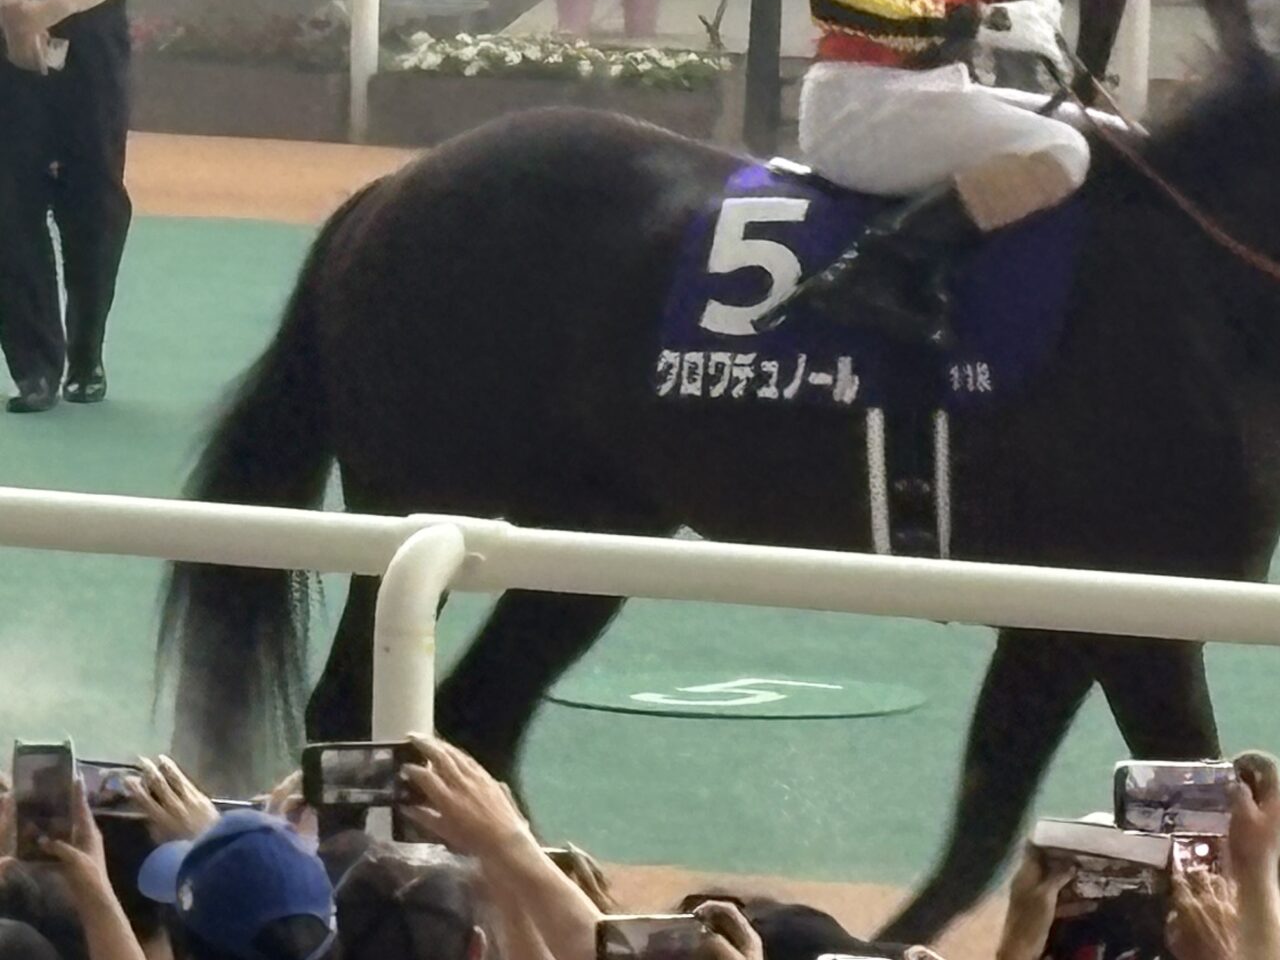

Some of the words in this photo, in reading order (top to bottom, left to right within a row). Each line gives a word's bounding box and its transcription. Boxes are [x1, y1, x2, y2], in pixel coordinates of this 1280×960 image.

[700, 197, 811, 335] 5
[656, 349, 860, 404] クロワデュノール
